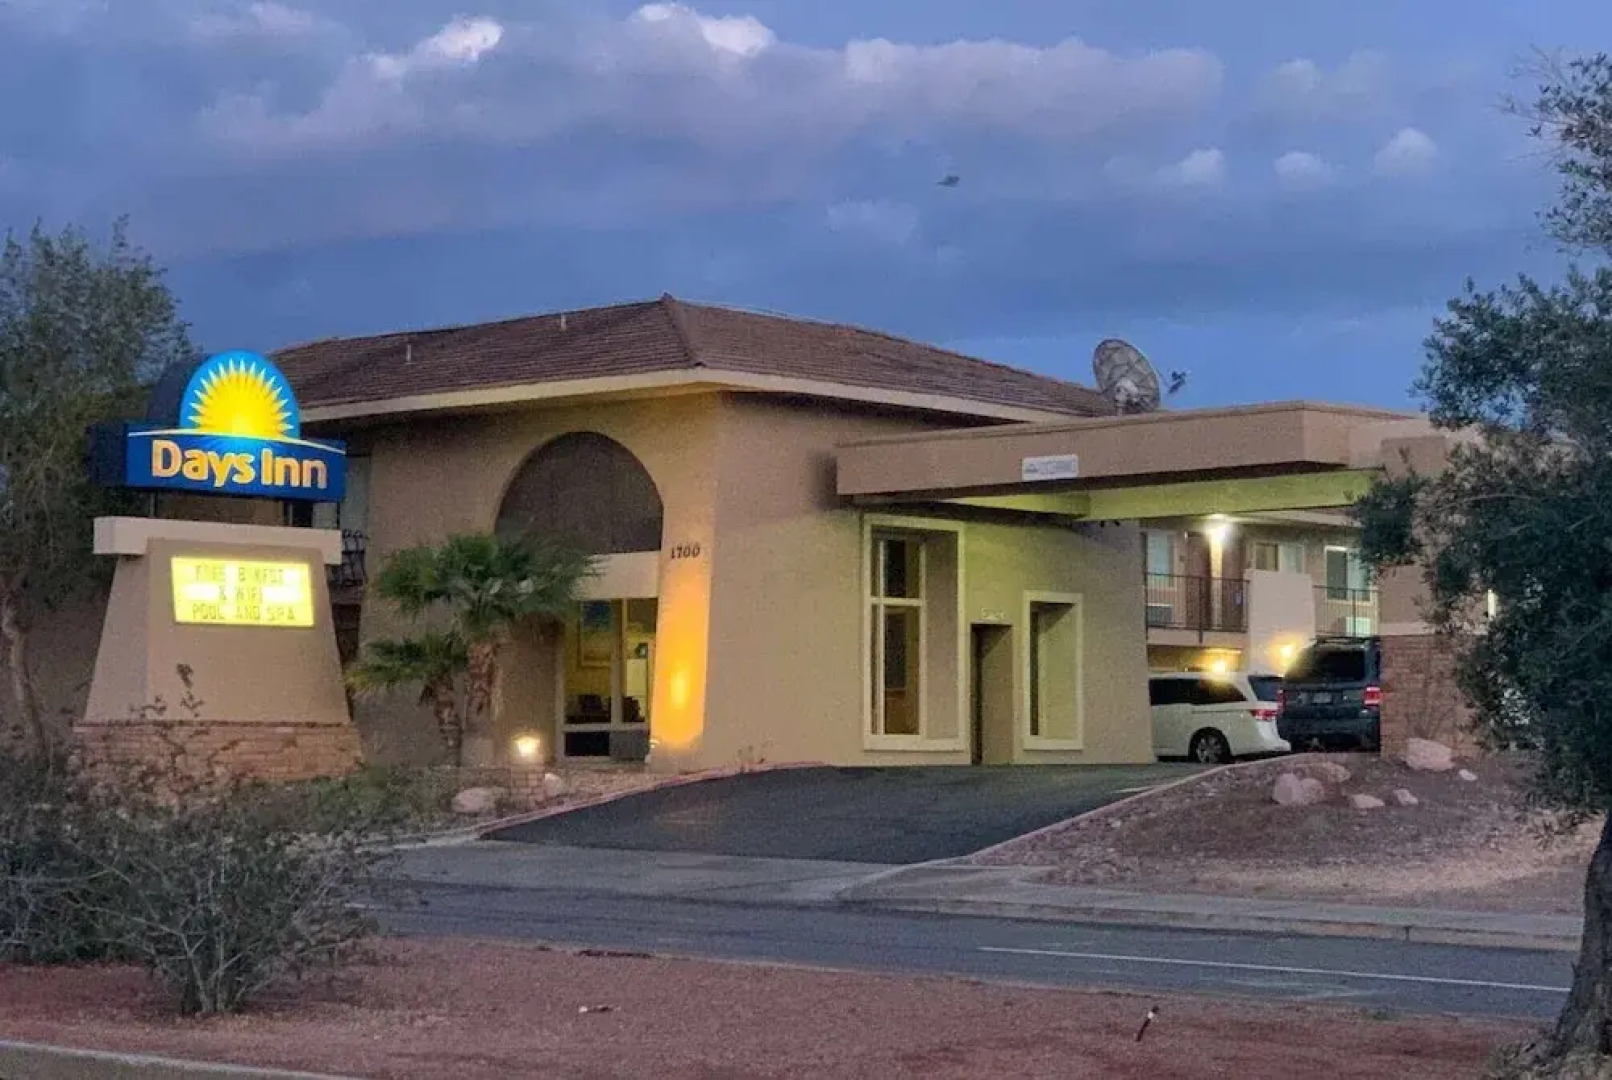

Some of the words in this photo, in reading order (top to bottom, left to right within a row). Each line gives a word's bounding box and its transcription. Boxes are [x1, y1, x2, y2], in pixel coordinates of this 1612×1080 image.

[152, 439, 256, 488] Days
[260, 447, 327, 490] Inn
[671, 542, 700, 559] 1700
[192, 603, 225, 620] POOL
[236, 605, 260, 620] AND
[266, 606, 296, 621] SPA
